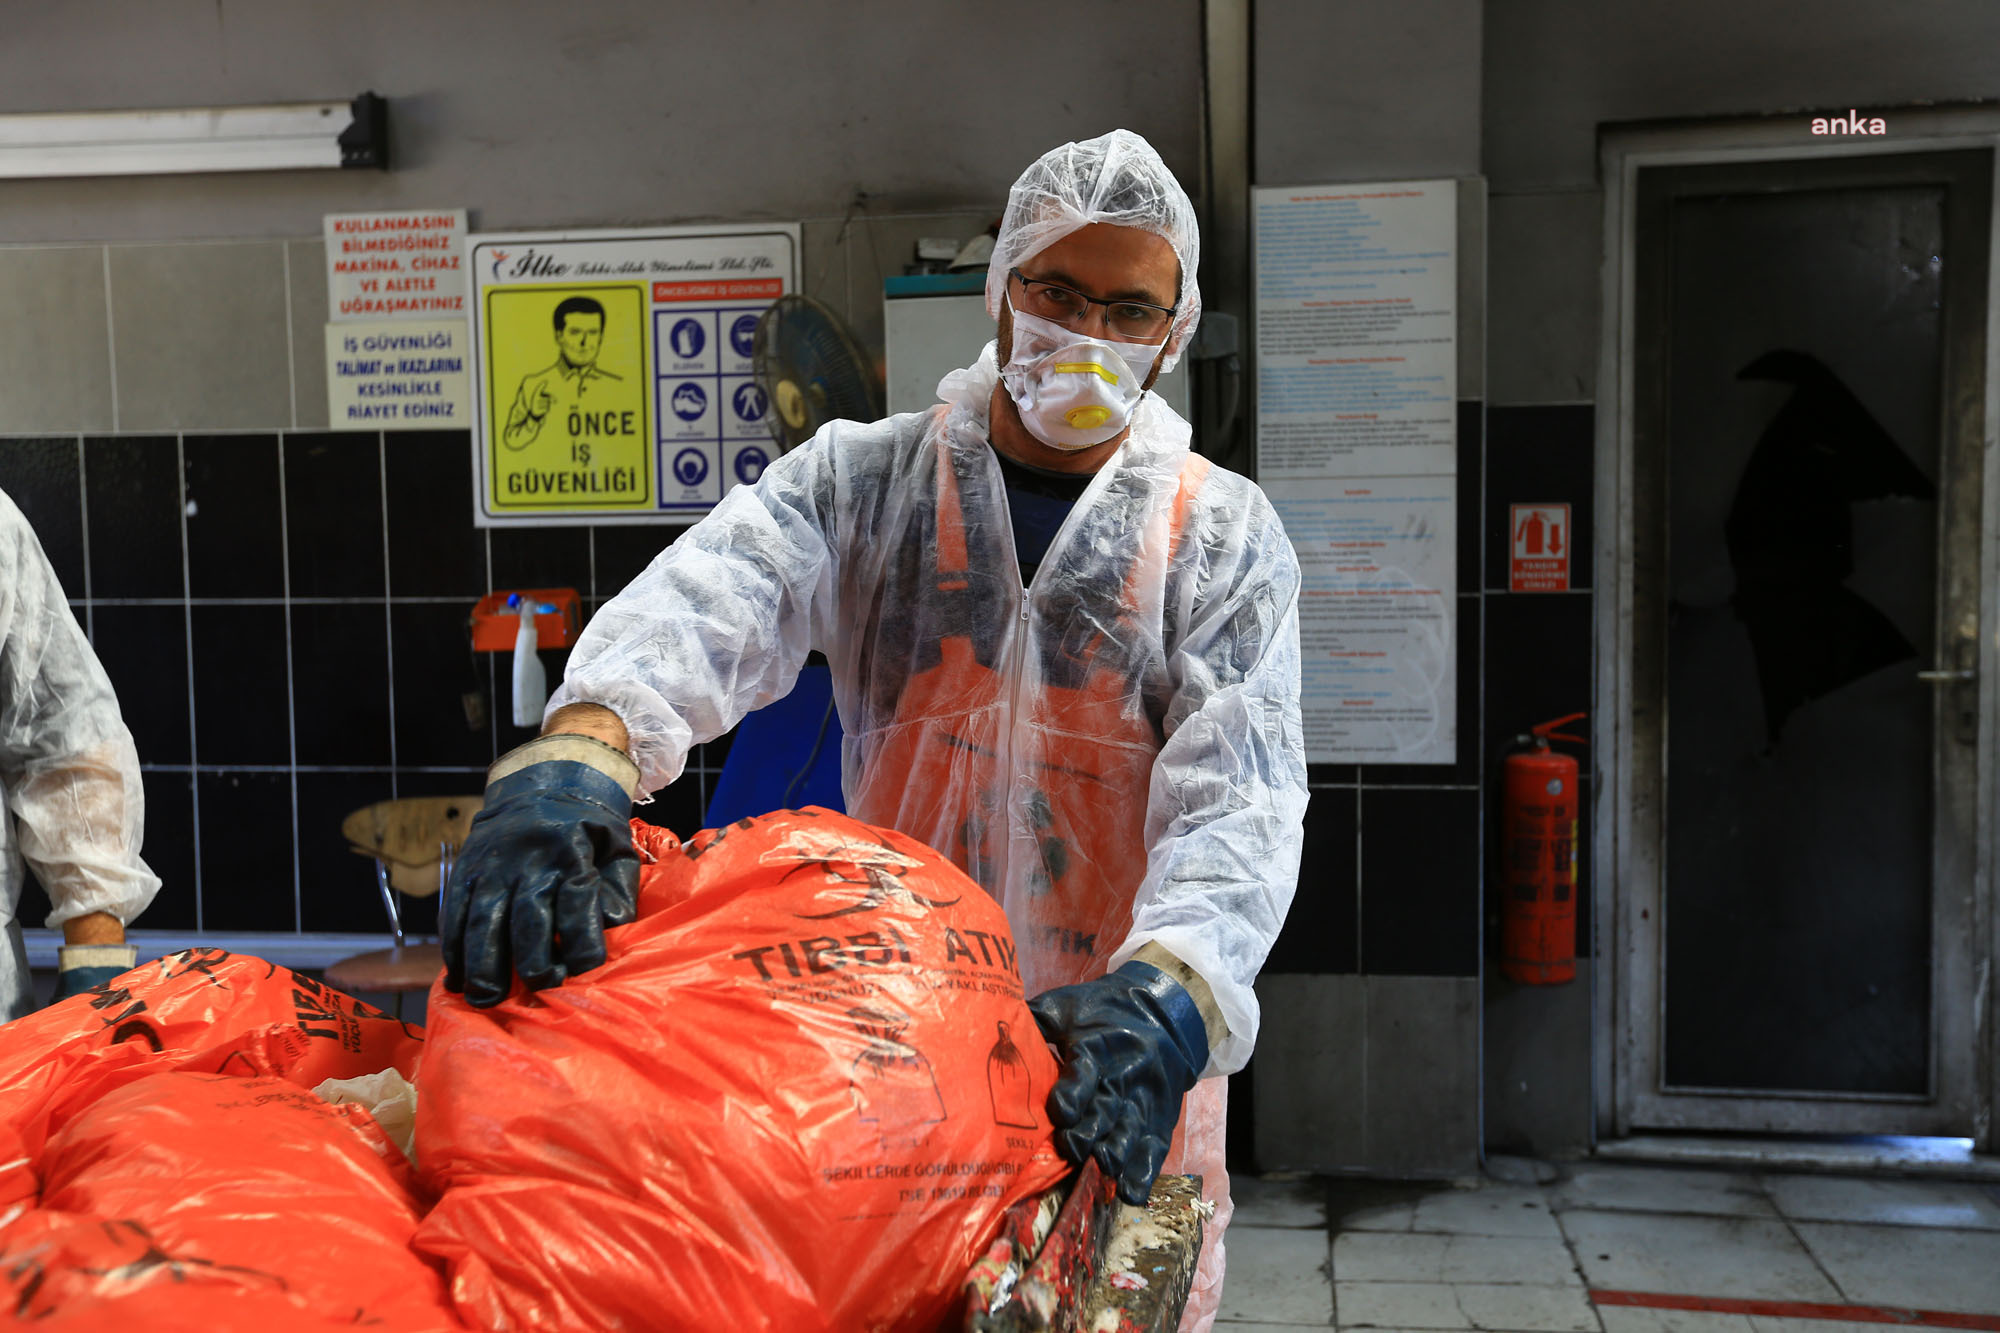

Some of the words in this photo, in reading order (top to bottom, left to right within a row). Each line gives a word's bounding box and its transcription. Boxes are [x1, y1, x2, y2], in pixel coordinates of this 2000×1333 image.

[334, 216, 455, 234] KULLANMASINI
[342, 235, 449, 254] BİLMEDİĞİNİZ
[411, 255, 460, 271] CİHAZ
[360, 279, 378, 293] VE
[386, 277, 436, 292] ALETLE
[340, 296, 463, 315] UĞRAŞMAYINIZ
[363, 332, 451, 352] GÜVENLİĞİ
[358, 379, 443, 398] KESİNLİKLE
[403, 399, 455, 418] EDİNİZ
[568, 405, 636, 437] ÖNCE
[572, 443, 591, 467] İŞ
[508, 467, 636, 496] GÜVENLİĞİ
[1027, 924, 1097, 957] TIK
